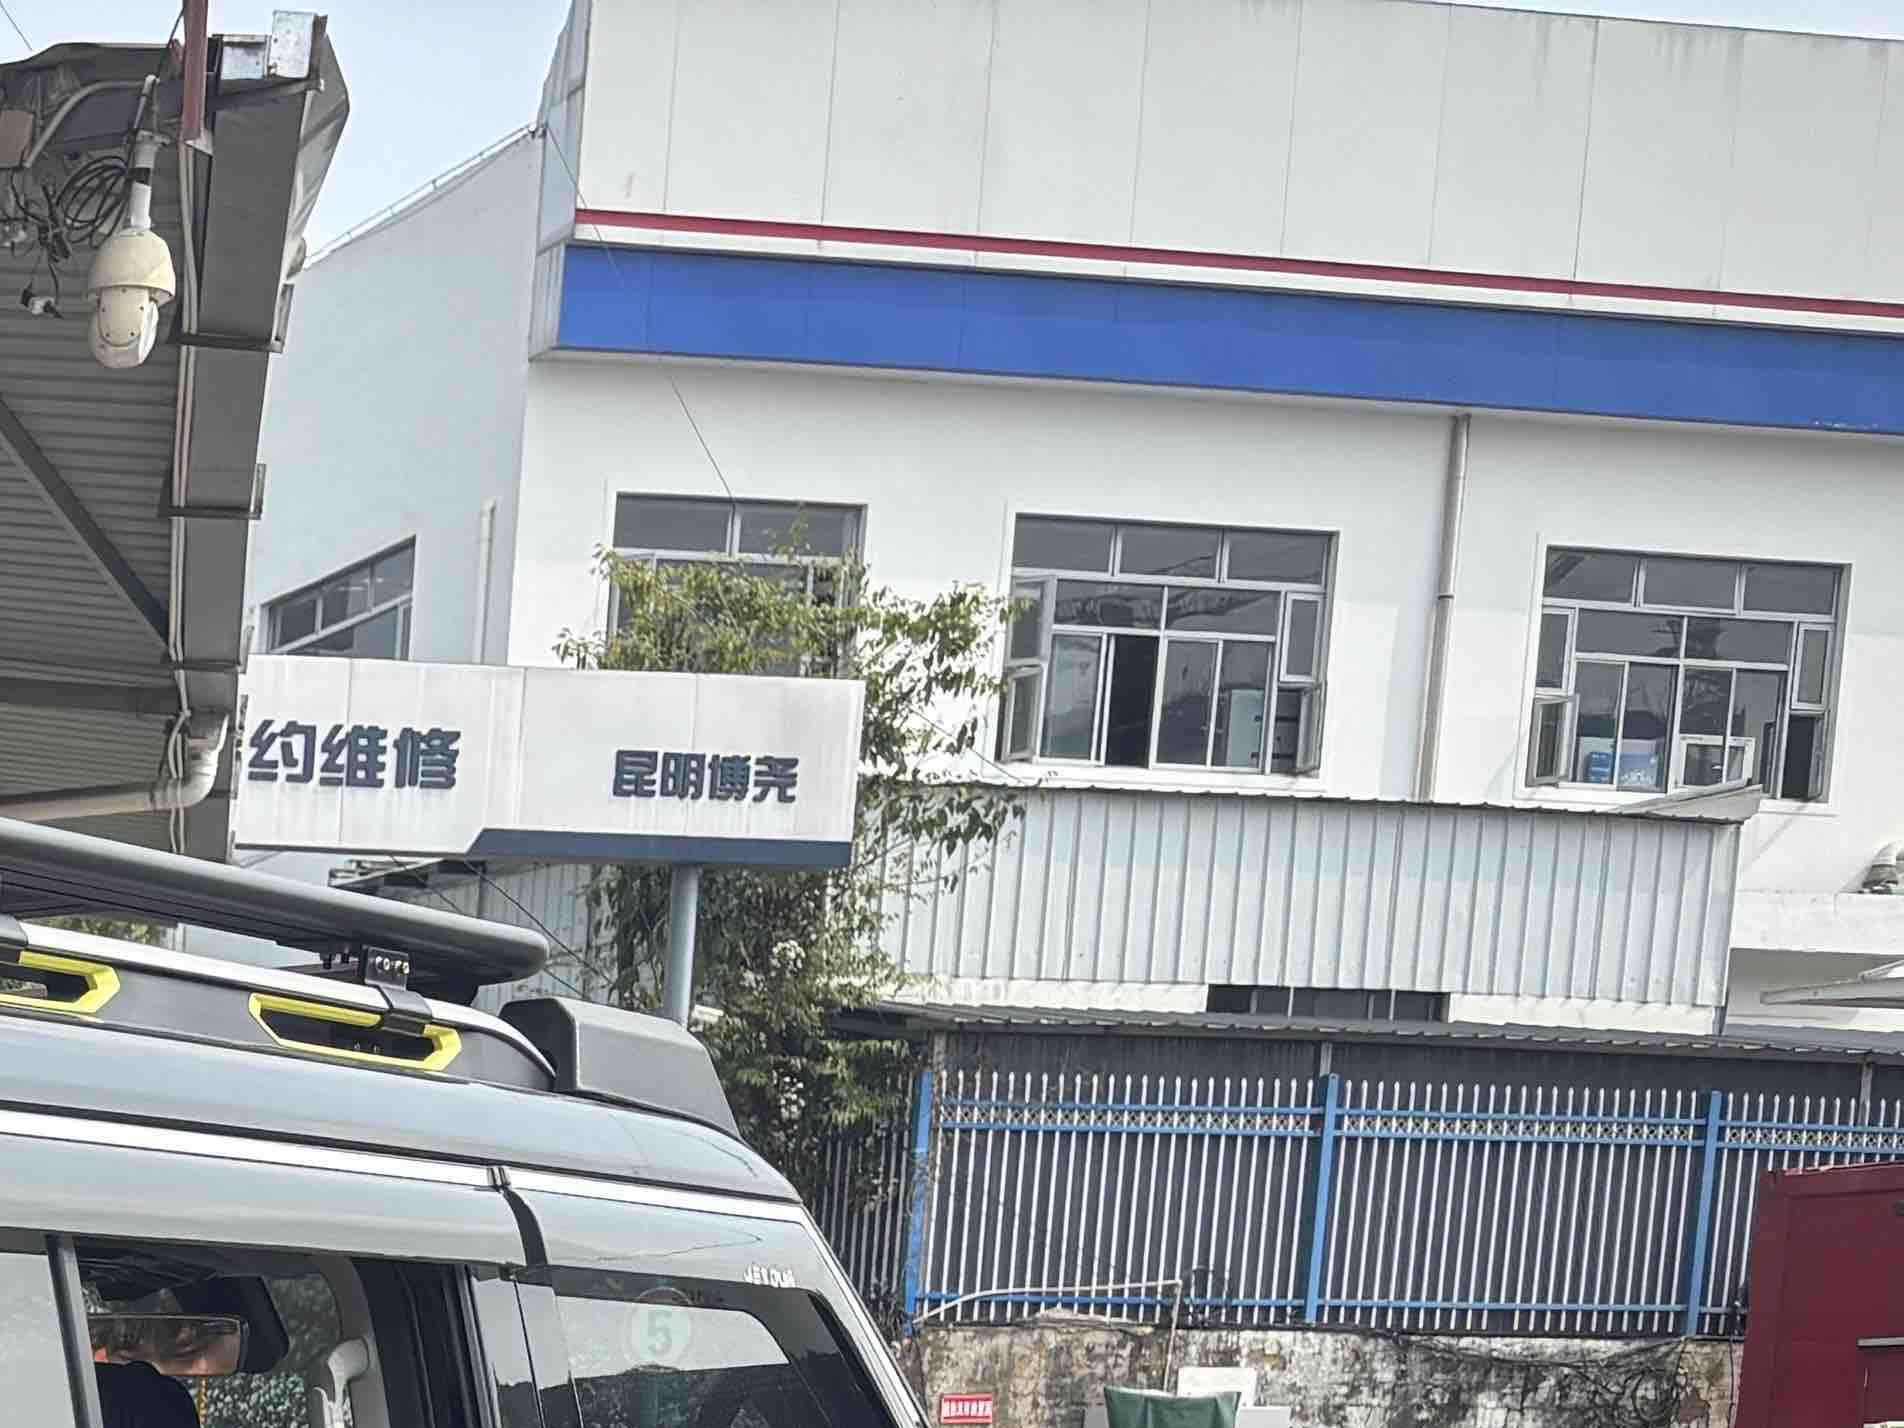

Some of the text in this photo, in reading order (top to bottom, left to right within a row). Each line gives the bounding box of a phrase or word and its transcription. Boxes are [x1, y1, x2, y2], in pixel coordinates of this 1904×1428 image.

[247, 719, 462, 790] 约维修
[613, 749, 800, 804] 昆明博尧
